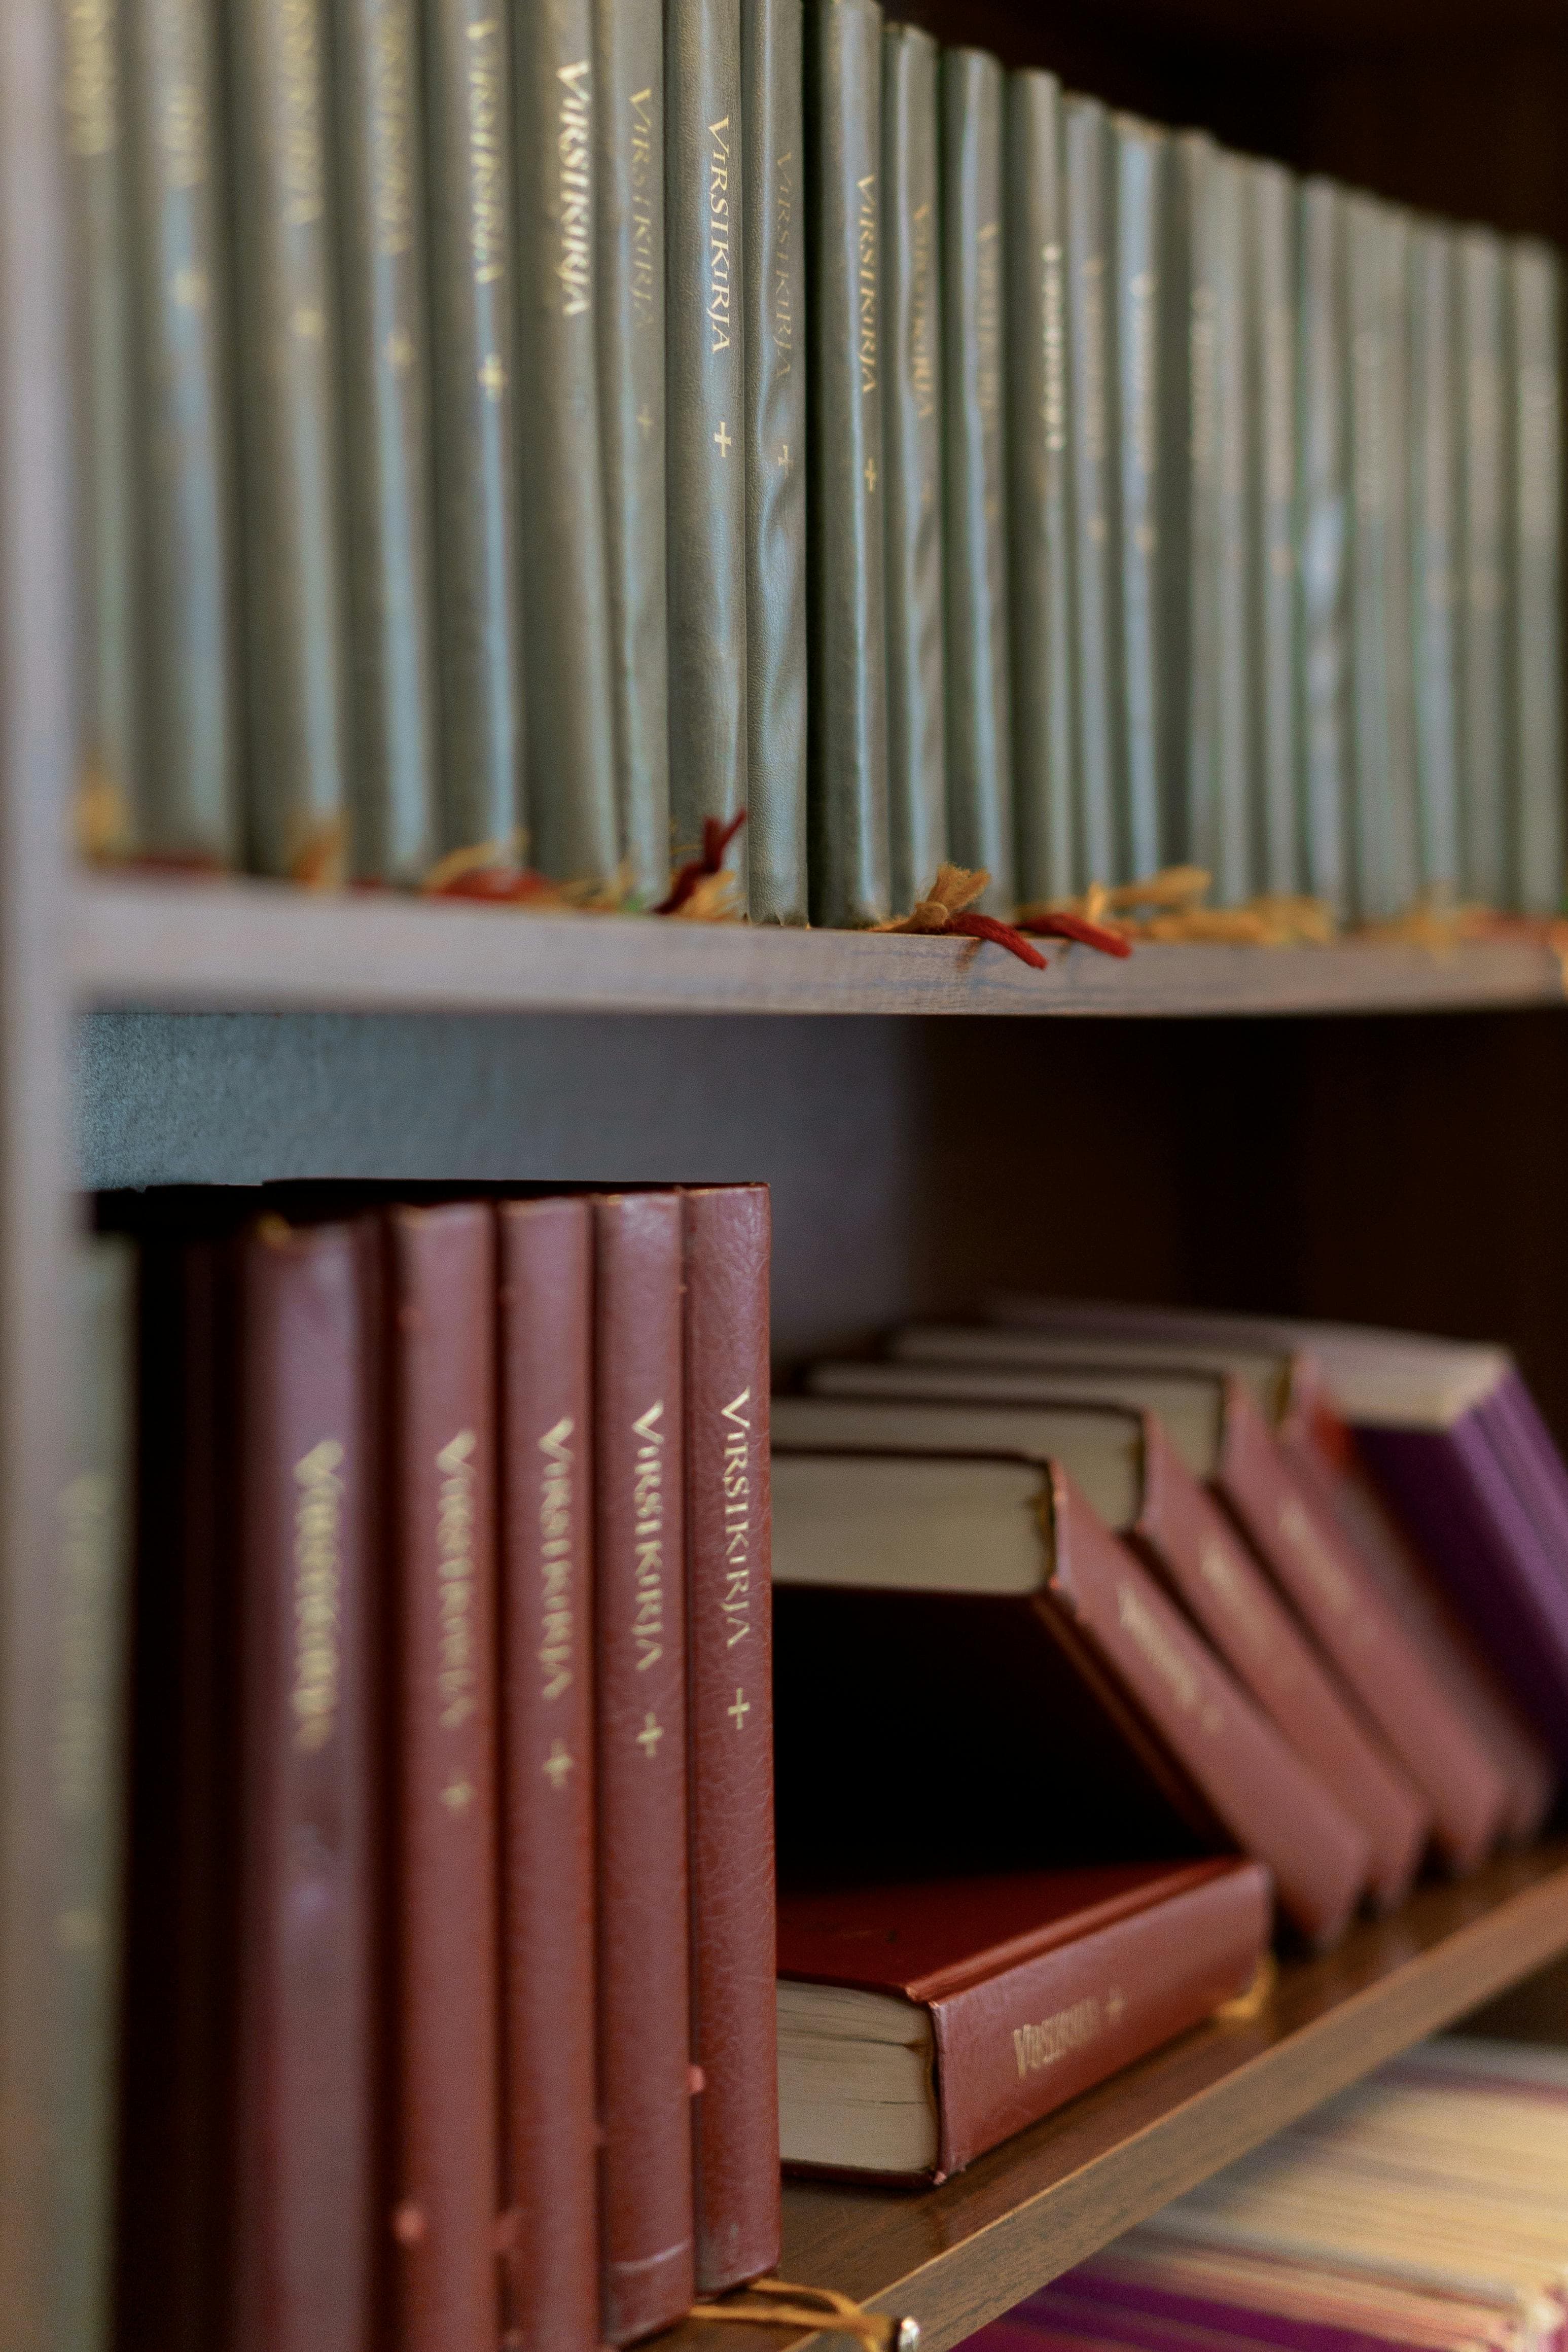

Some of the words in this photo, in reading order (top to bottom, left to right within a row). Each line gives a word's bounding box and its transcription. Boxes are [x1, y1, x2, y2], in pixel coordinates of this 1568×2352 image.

[557, 61, 589, 316] VIRSIKIRJA
[707, 115, 730, 353] VIRSIKIRJA
[774, 152, 793, 378] VIRSIKIRJA
[857, 174, 876, 393] VIRSIKIRJA
[632, 1399, 664, 1671] VIRSIKIRJA
[721, 1386, 751, 1648] VIRSIKIRJA
